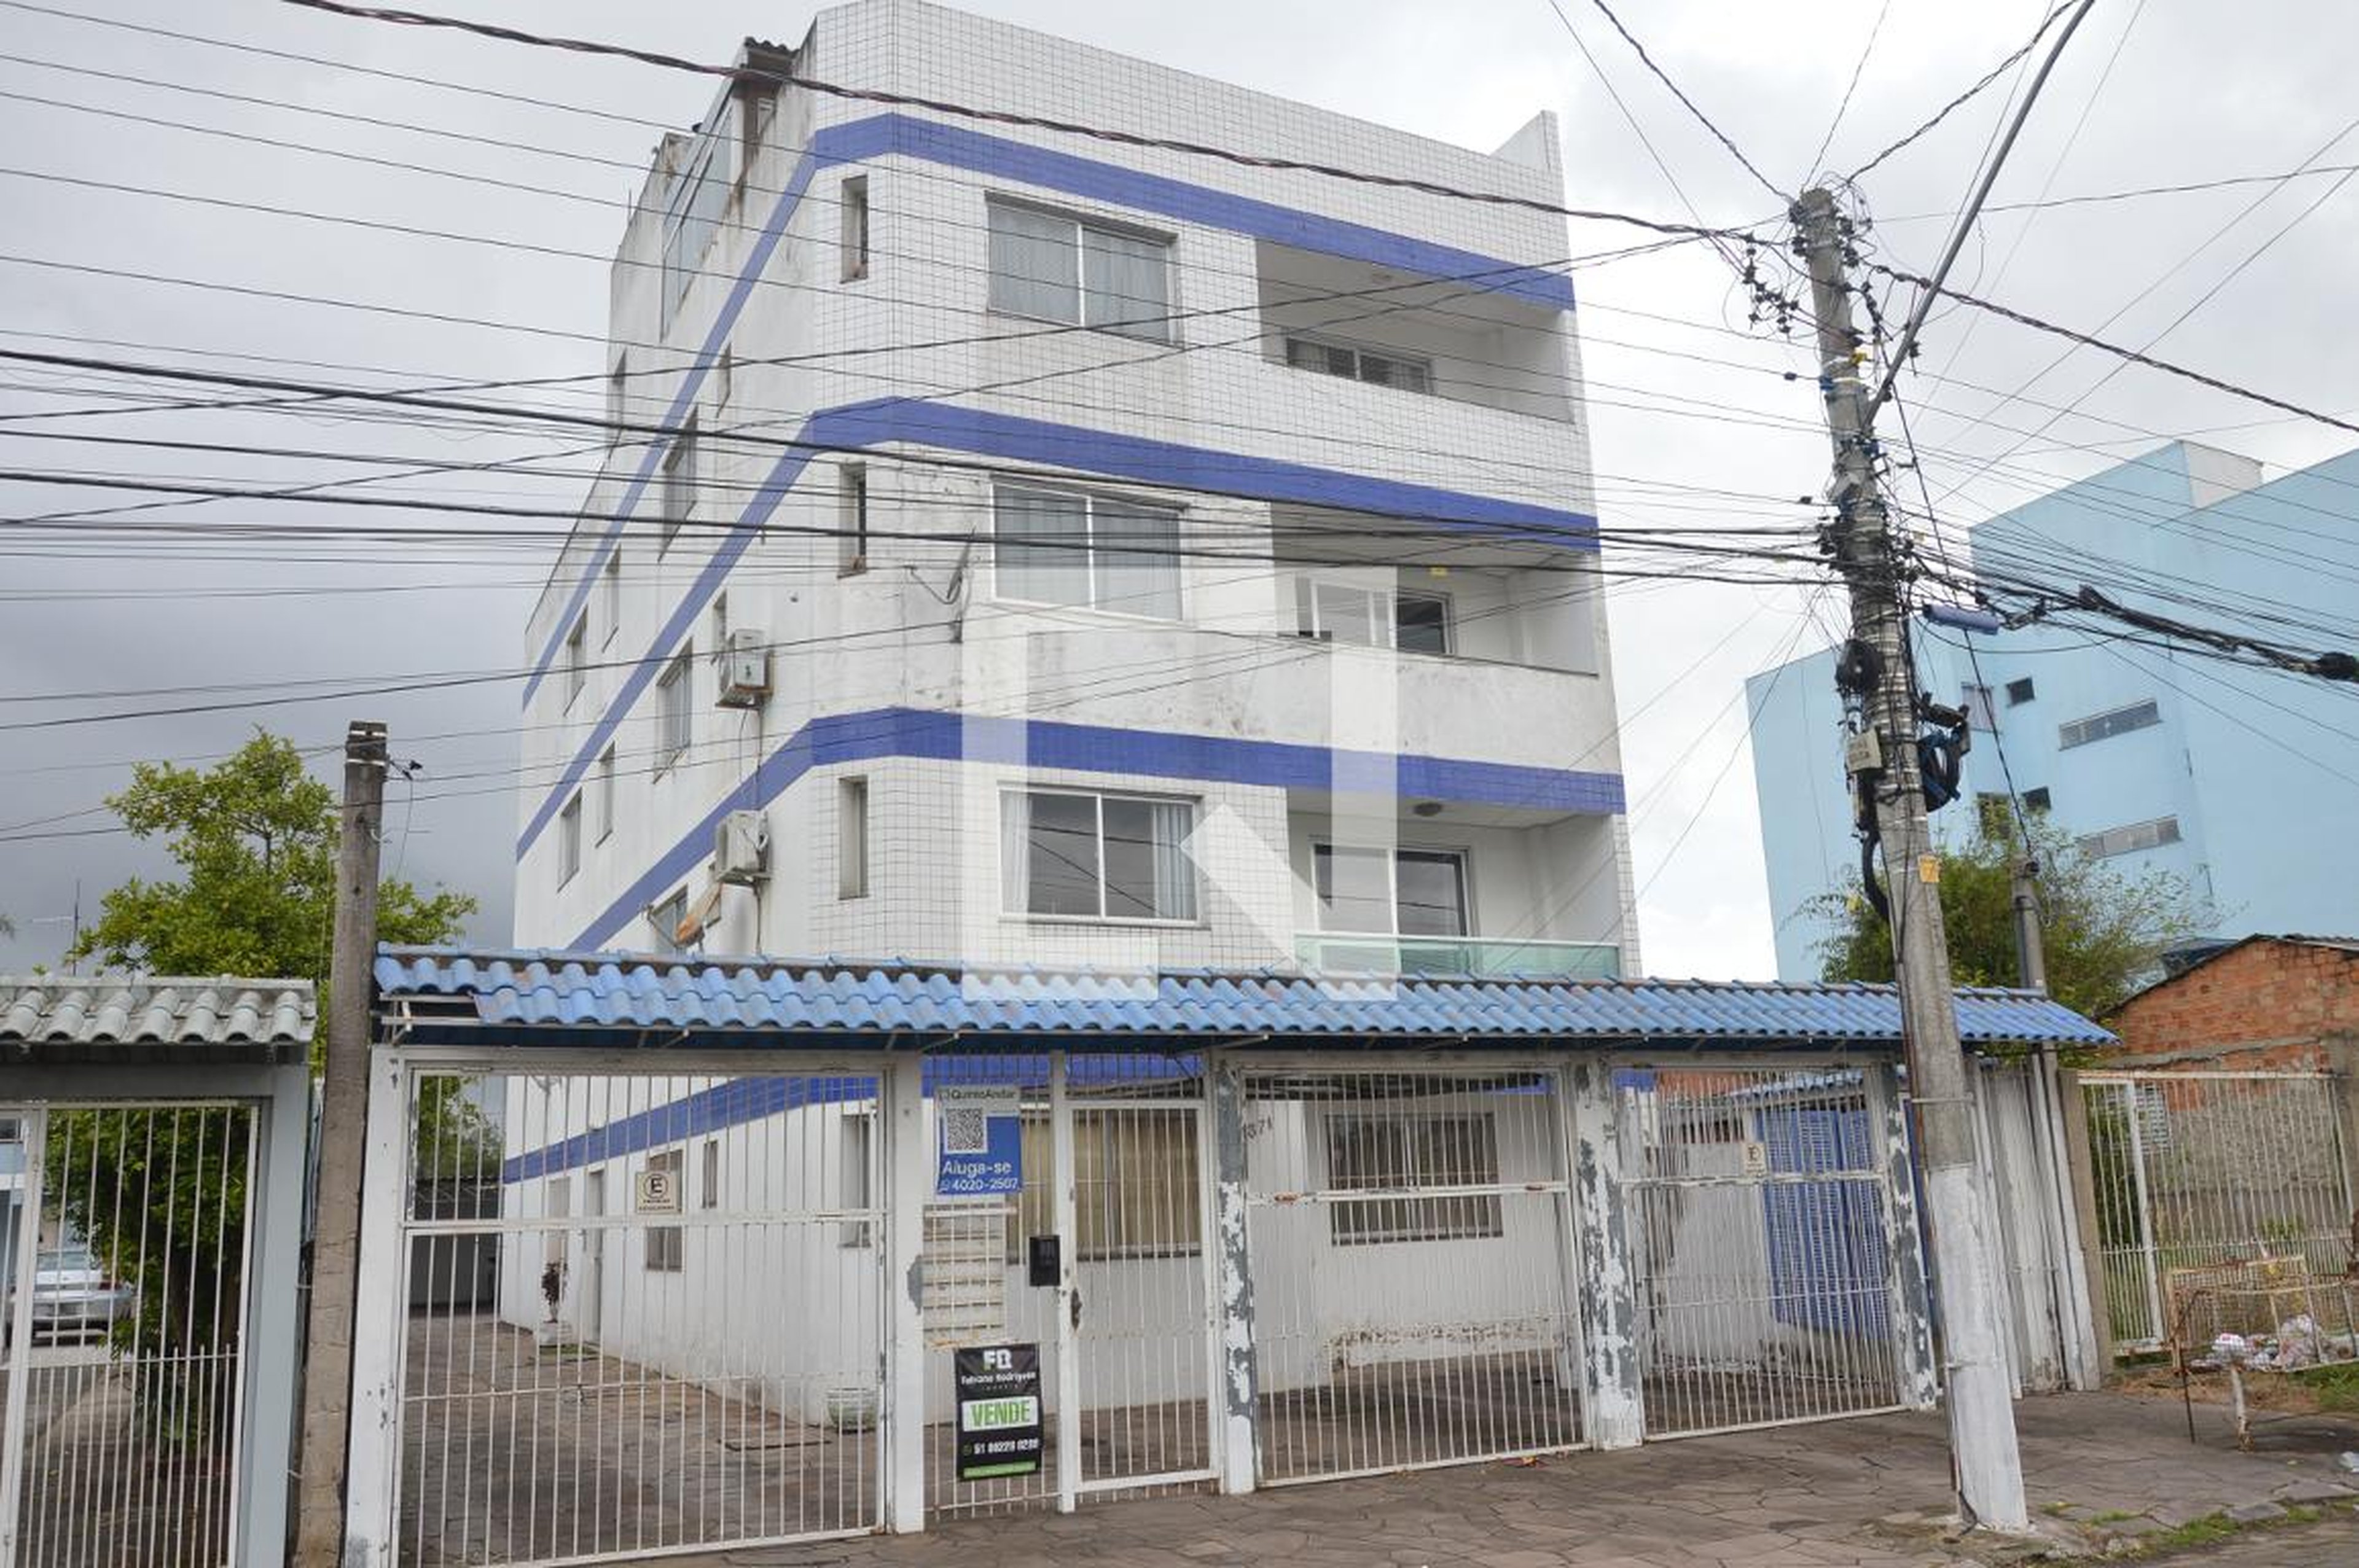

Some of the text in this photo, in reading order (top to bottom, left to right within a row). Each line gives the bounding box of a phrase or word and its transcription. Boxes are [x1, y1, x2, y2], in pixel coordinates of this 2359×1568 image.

[942, 1160, 1013, 1178] Aluga-se
[651, 1177, 663, 1193] E
[970, 1400, 1031, 1427] VENDE
[974, 1443, 985, 1454] 51
